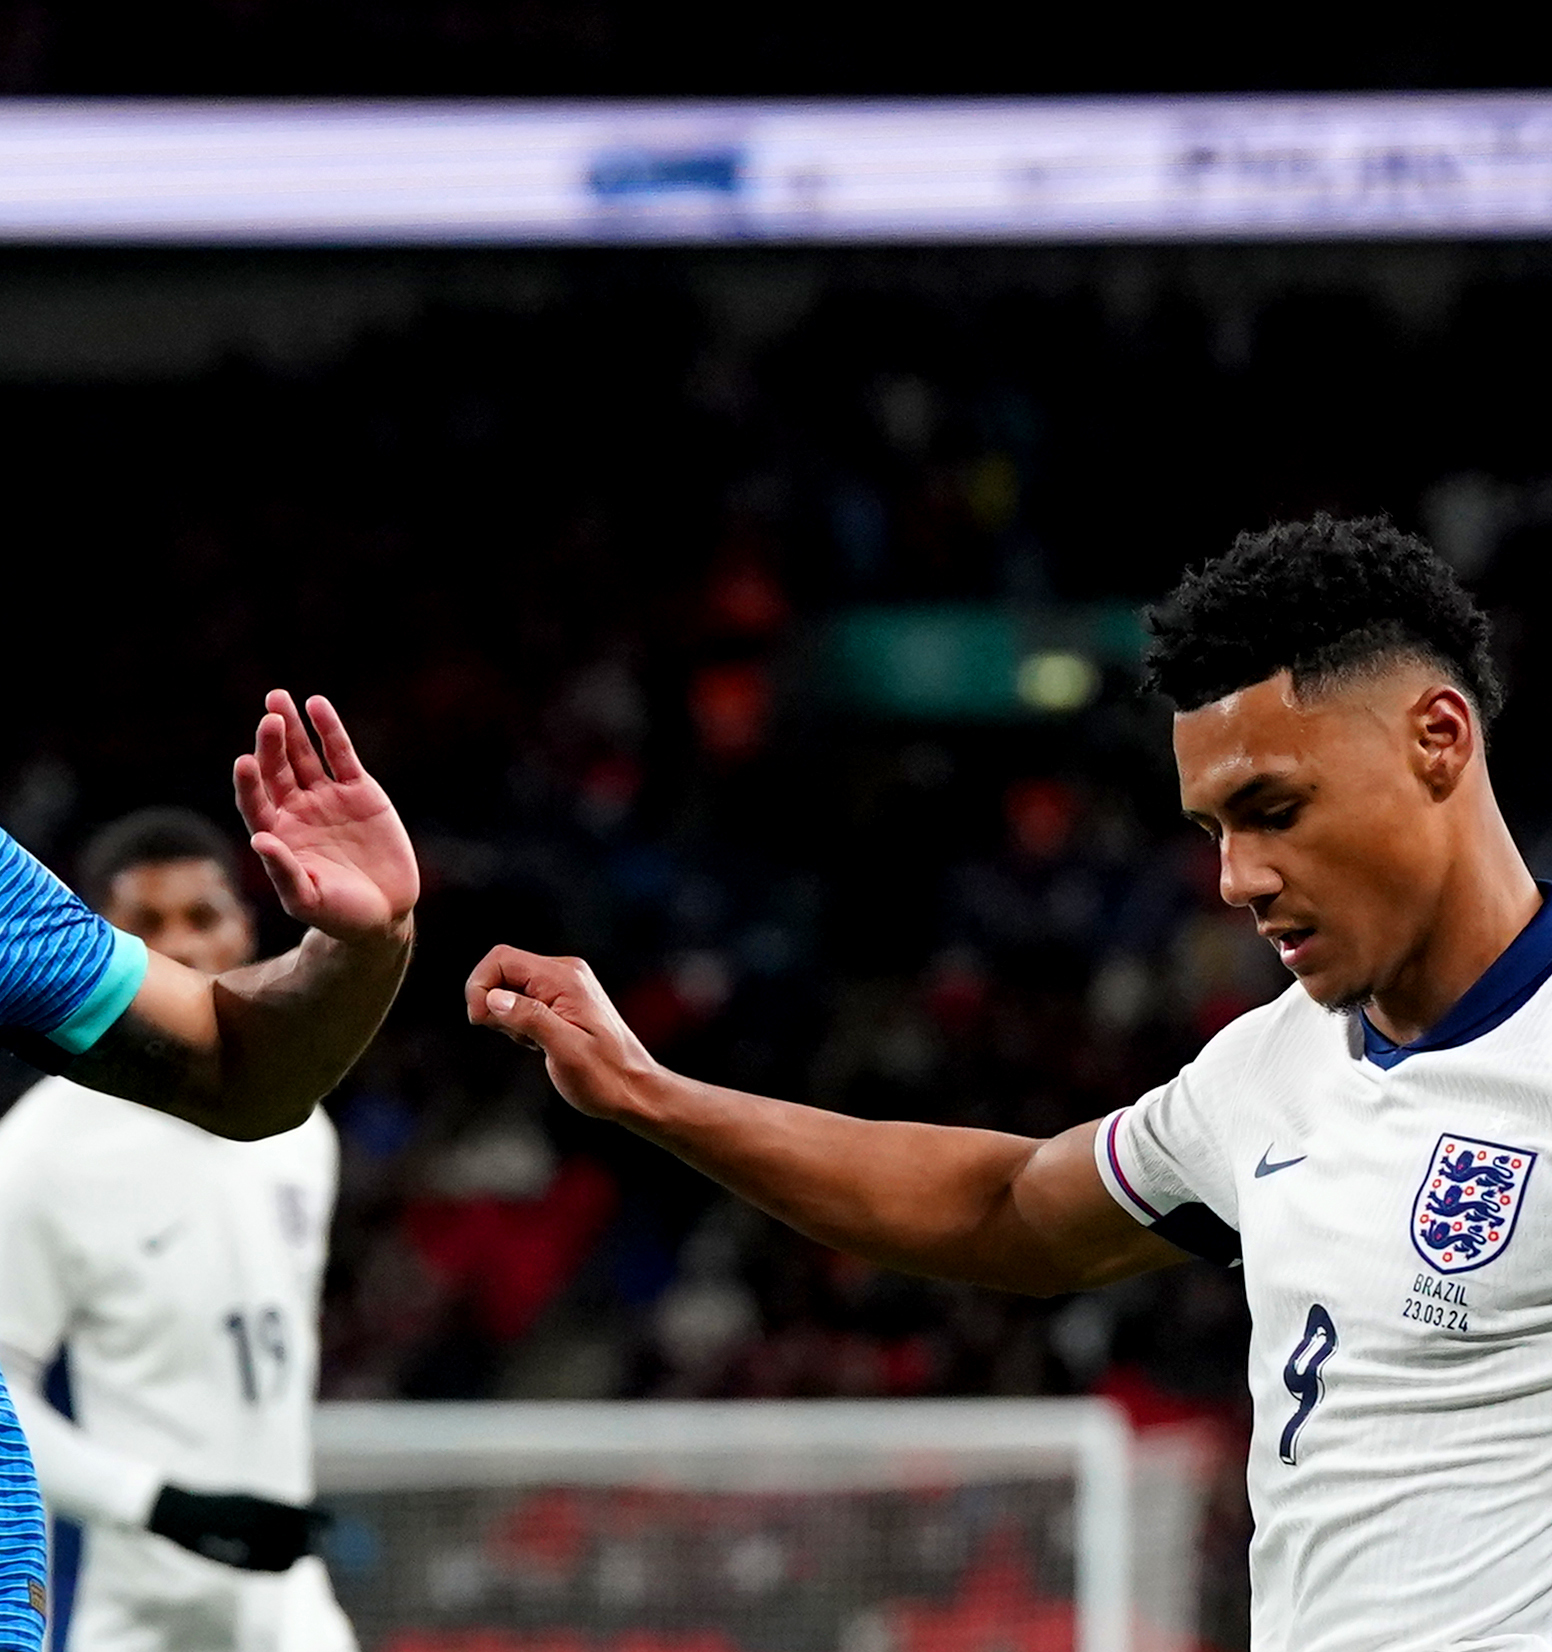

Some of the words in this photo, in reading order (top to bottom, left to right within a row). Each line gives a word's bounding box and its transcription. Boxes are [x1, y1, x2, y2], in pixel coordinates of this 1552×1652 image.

[1413, 1273, 1468, 1307] BRAZIL
[1402, 1298, 1468, 1333] 23.03.24
[1279, 1303, 1339, 1466] 9
